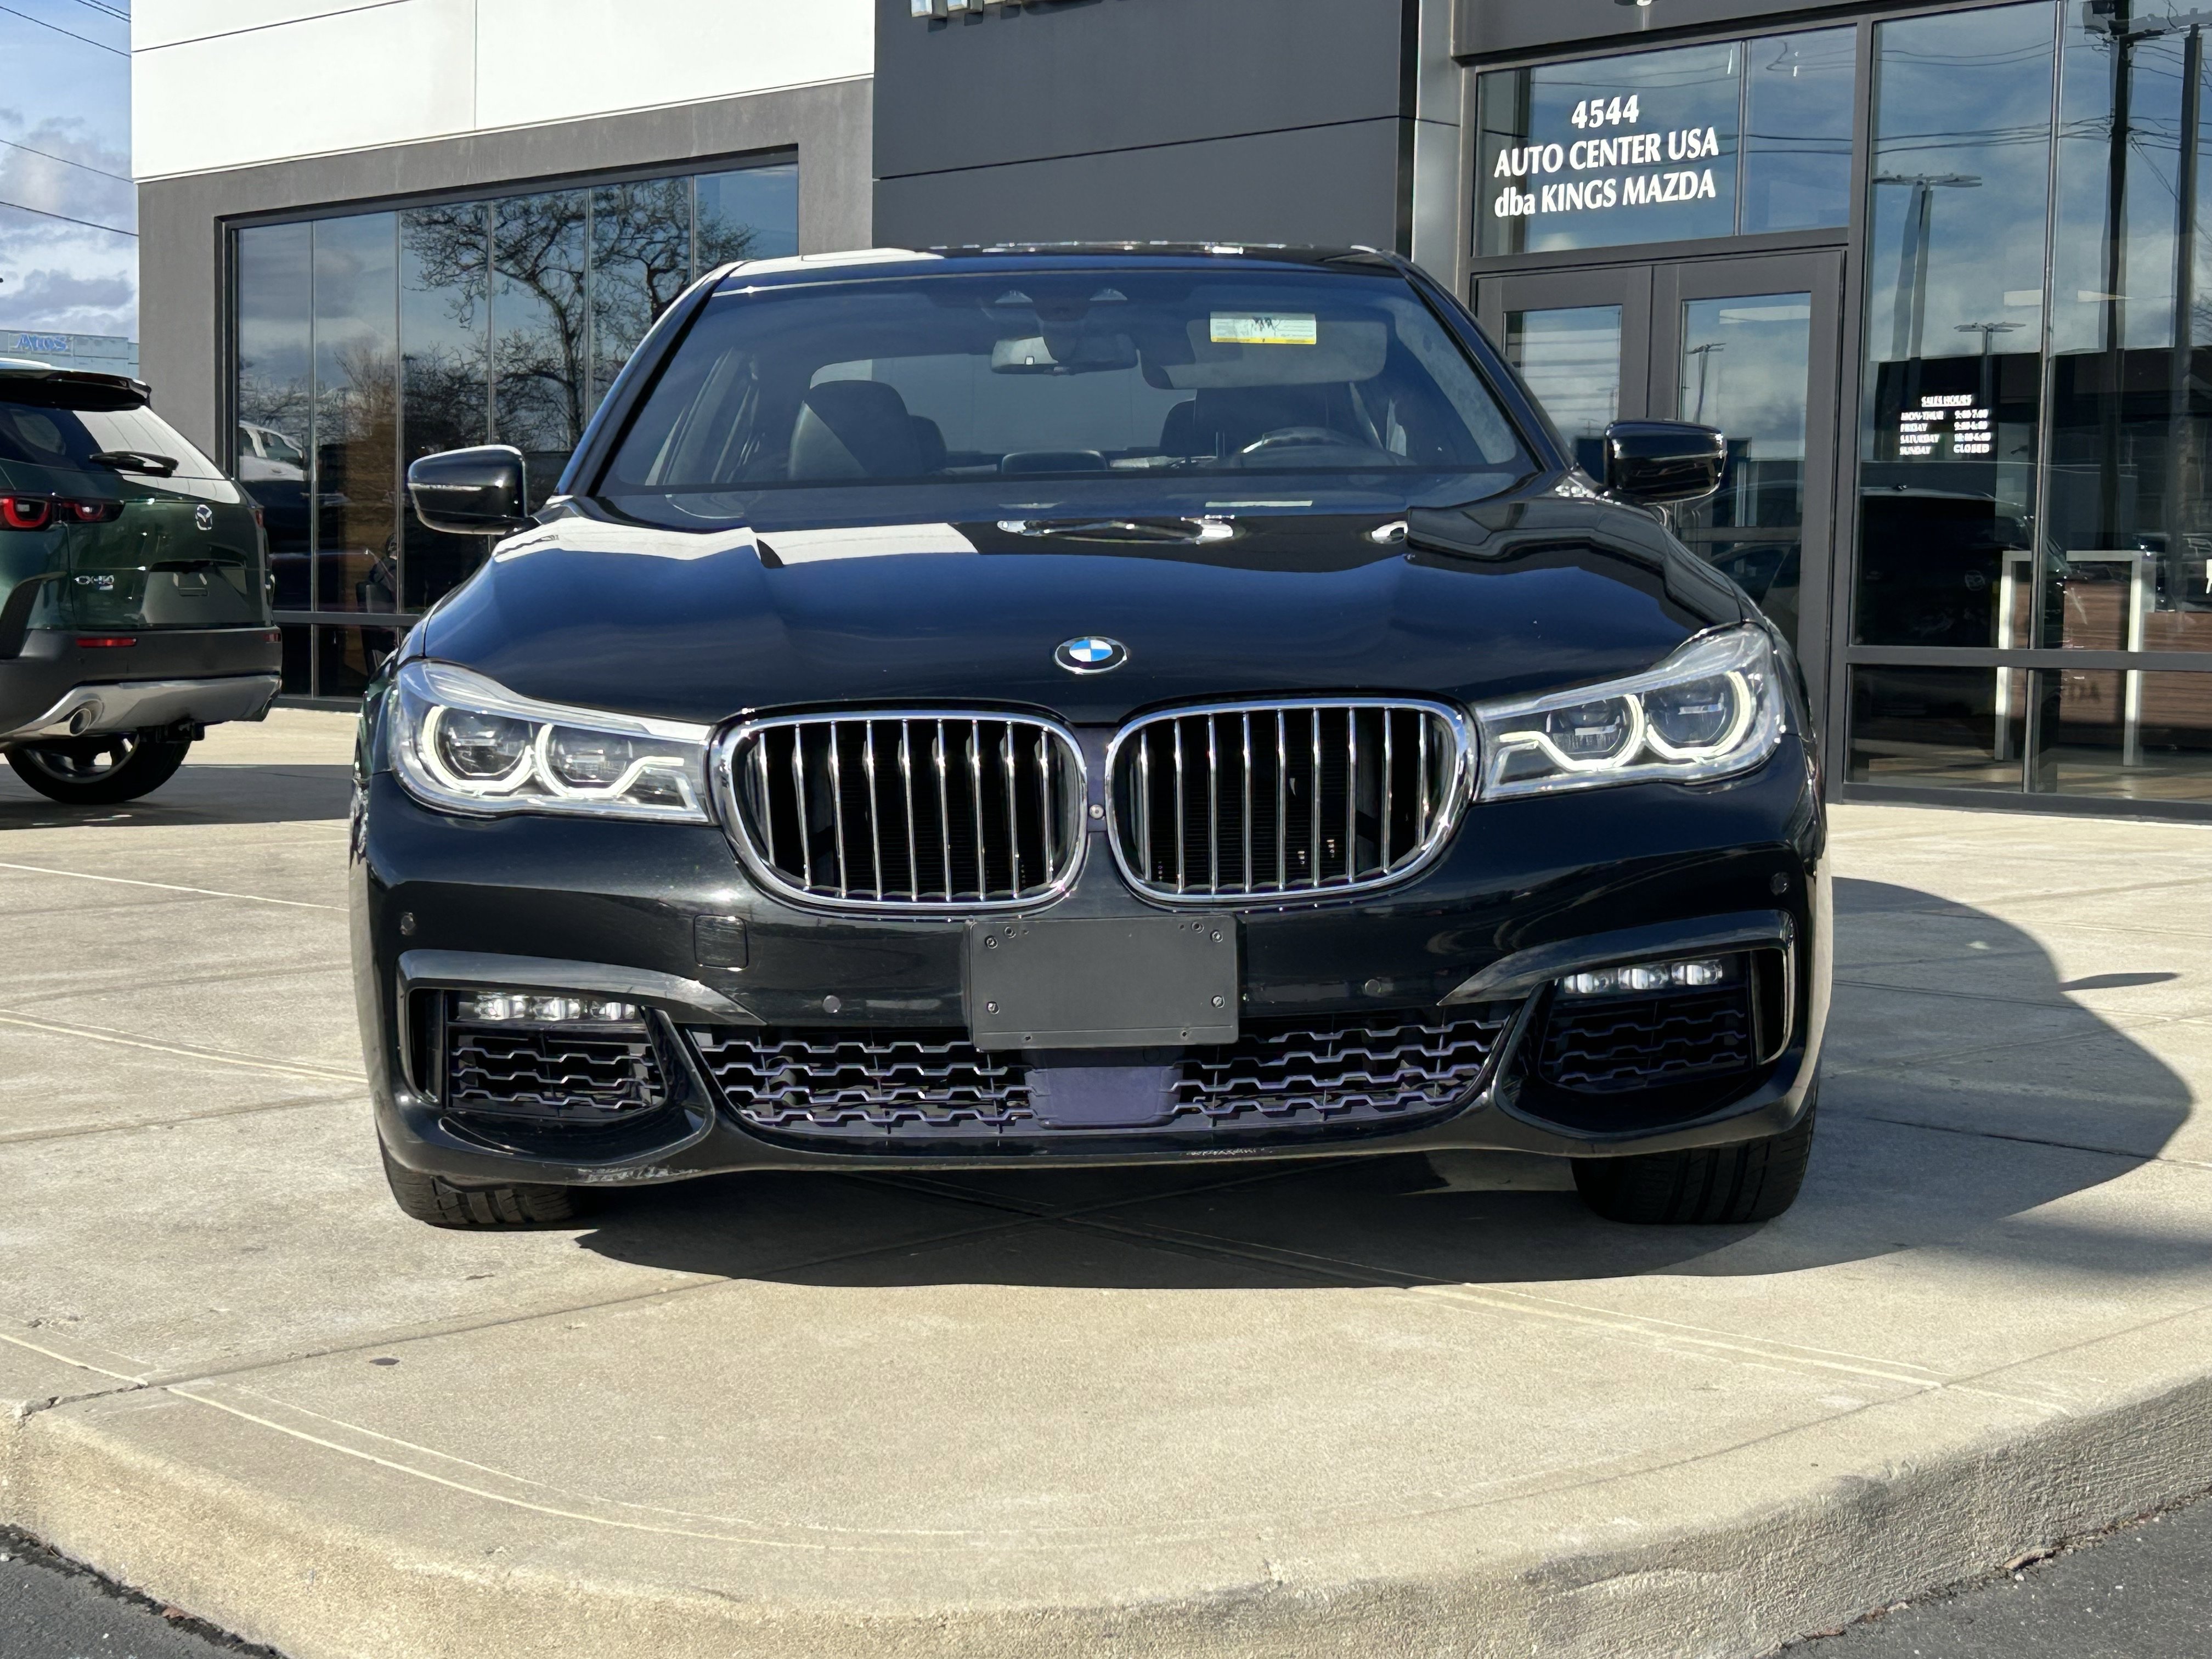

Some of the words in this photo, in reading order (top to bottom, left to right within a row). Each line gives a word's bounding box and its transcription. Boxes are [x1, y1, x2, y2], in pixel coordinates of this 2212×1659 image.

[1571, 95, 1640, 129] 4544
[1494, 144, 1564, 178] AUTO
[1570, 133, 1661, 170] CENTER
[1668, 127, 1719, 160] USA
[1494, 186, 1536, 217] dba
[1542, 178, 1617, 213] KINGS
[1622, 169, 1716, 206] MAZDA
[1899, 445, 1932, 455] SUNDAY
[1953, 443, 1990, 454] CLOSED
